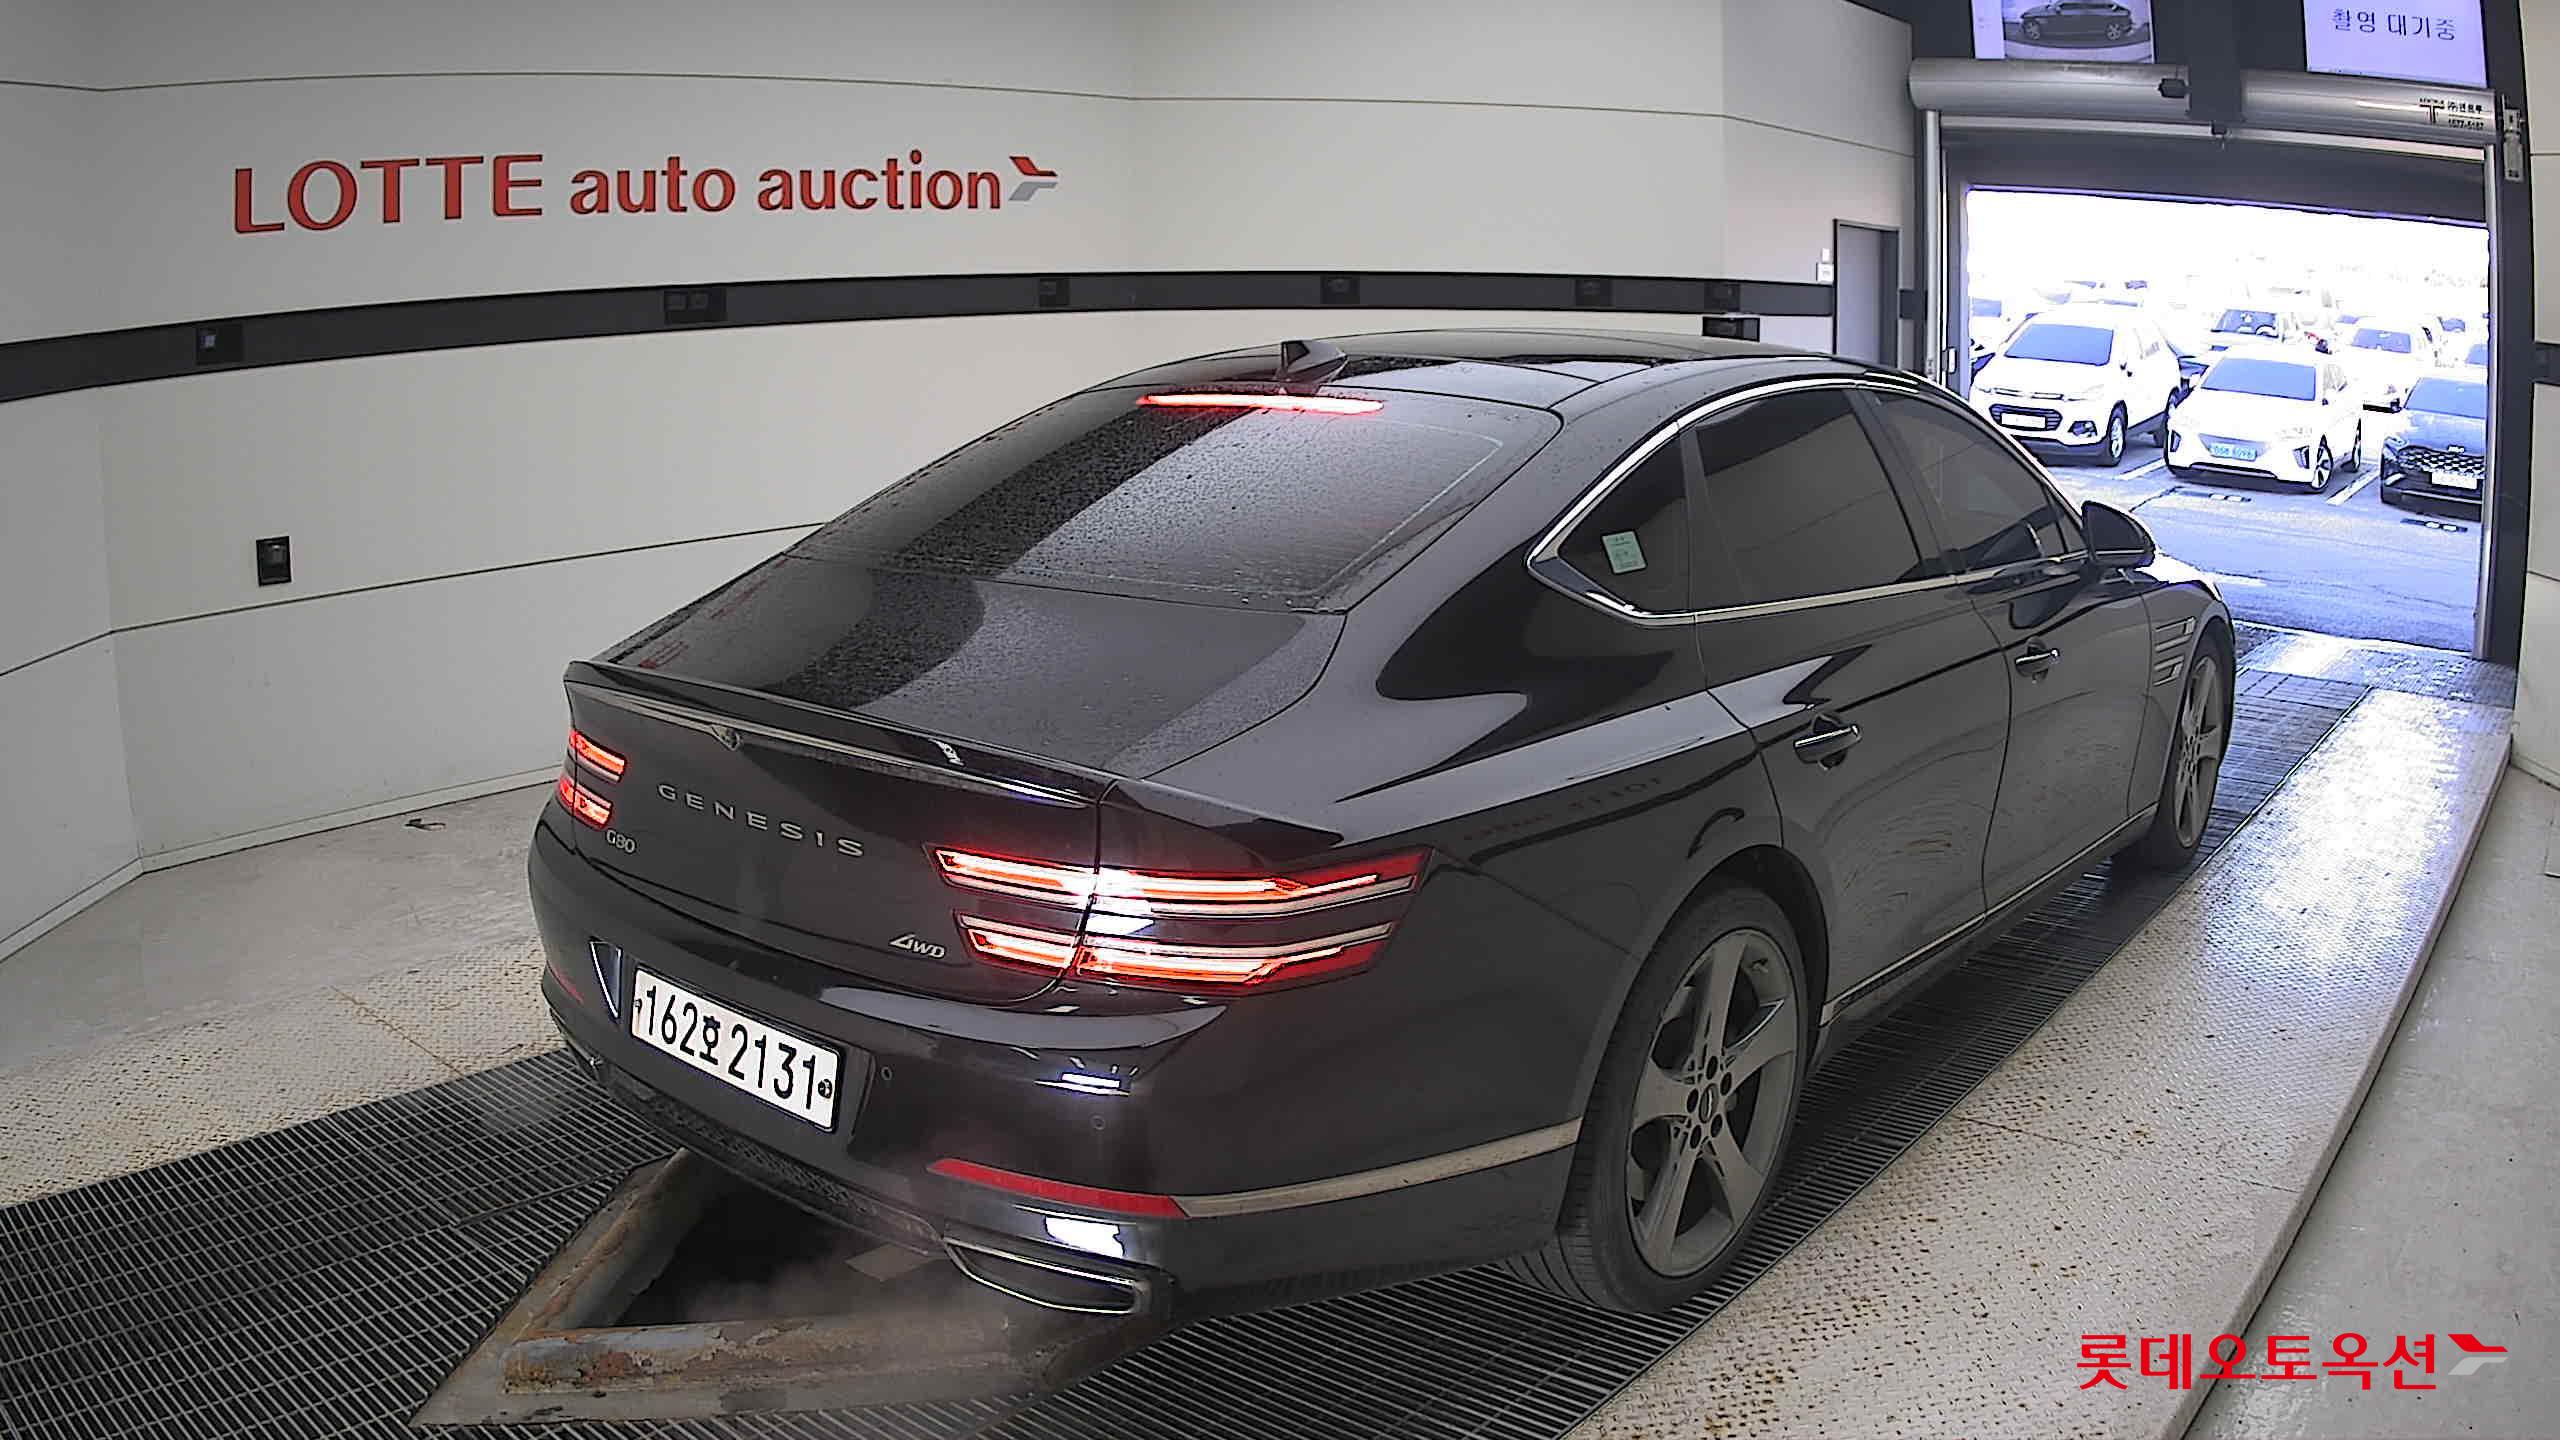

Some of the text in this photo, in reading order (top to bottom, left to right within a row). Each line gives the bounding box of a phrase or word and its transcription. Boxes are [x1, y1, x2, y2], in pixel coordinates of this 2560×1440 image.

[2332, 9, 2456, 41] 촬영 대기중
[235, 149, 1001, 234] LOTTE auto auction
[606, 829, 637, 853] G80
[657, 783, 864, 857] GENESIS
[889, 934, 945, 958] 4WD
[646, 985, 817, 1110] 162호2131
